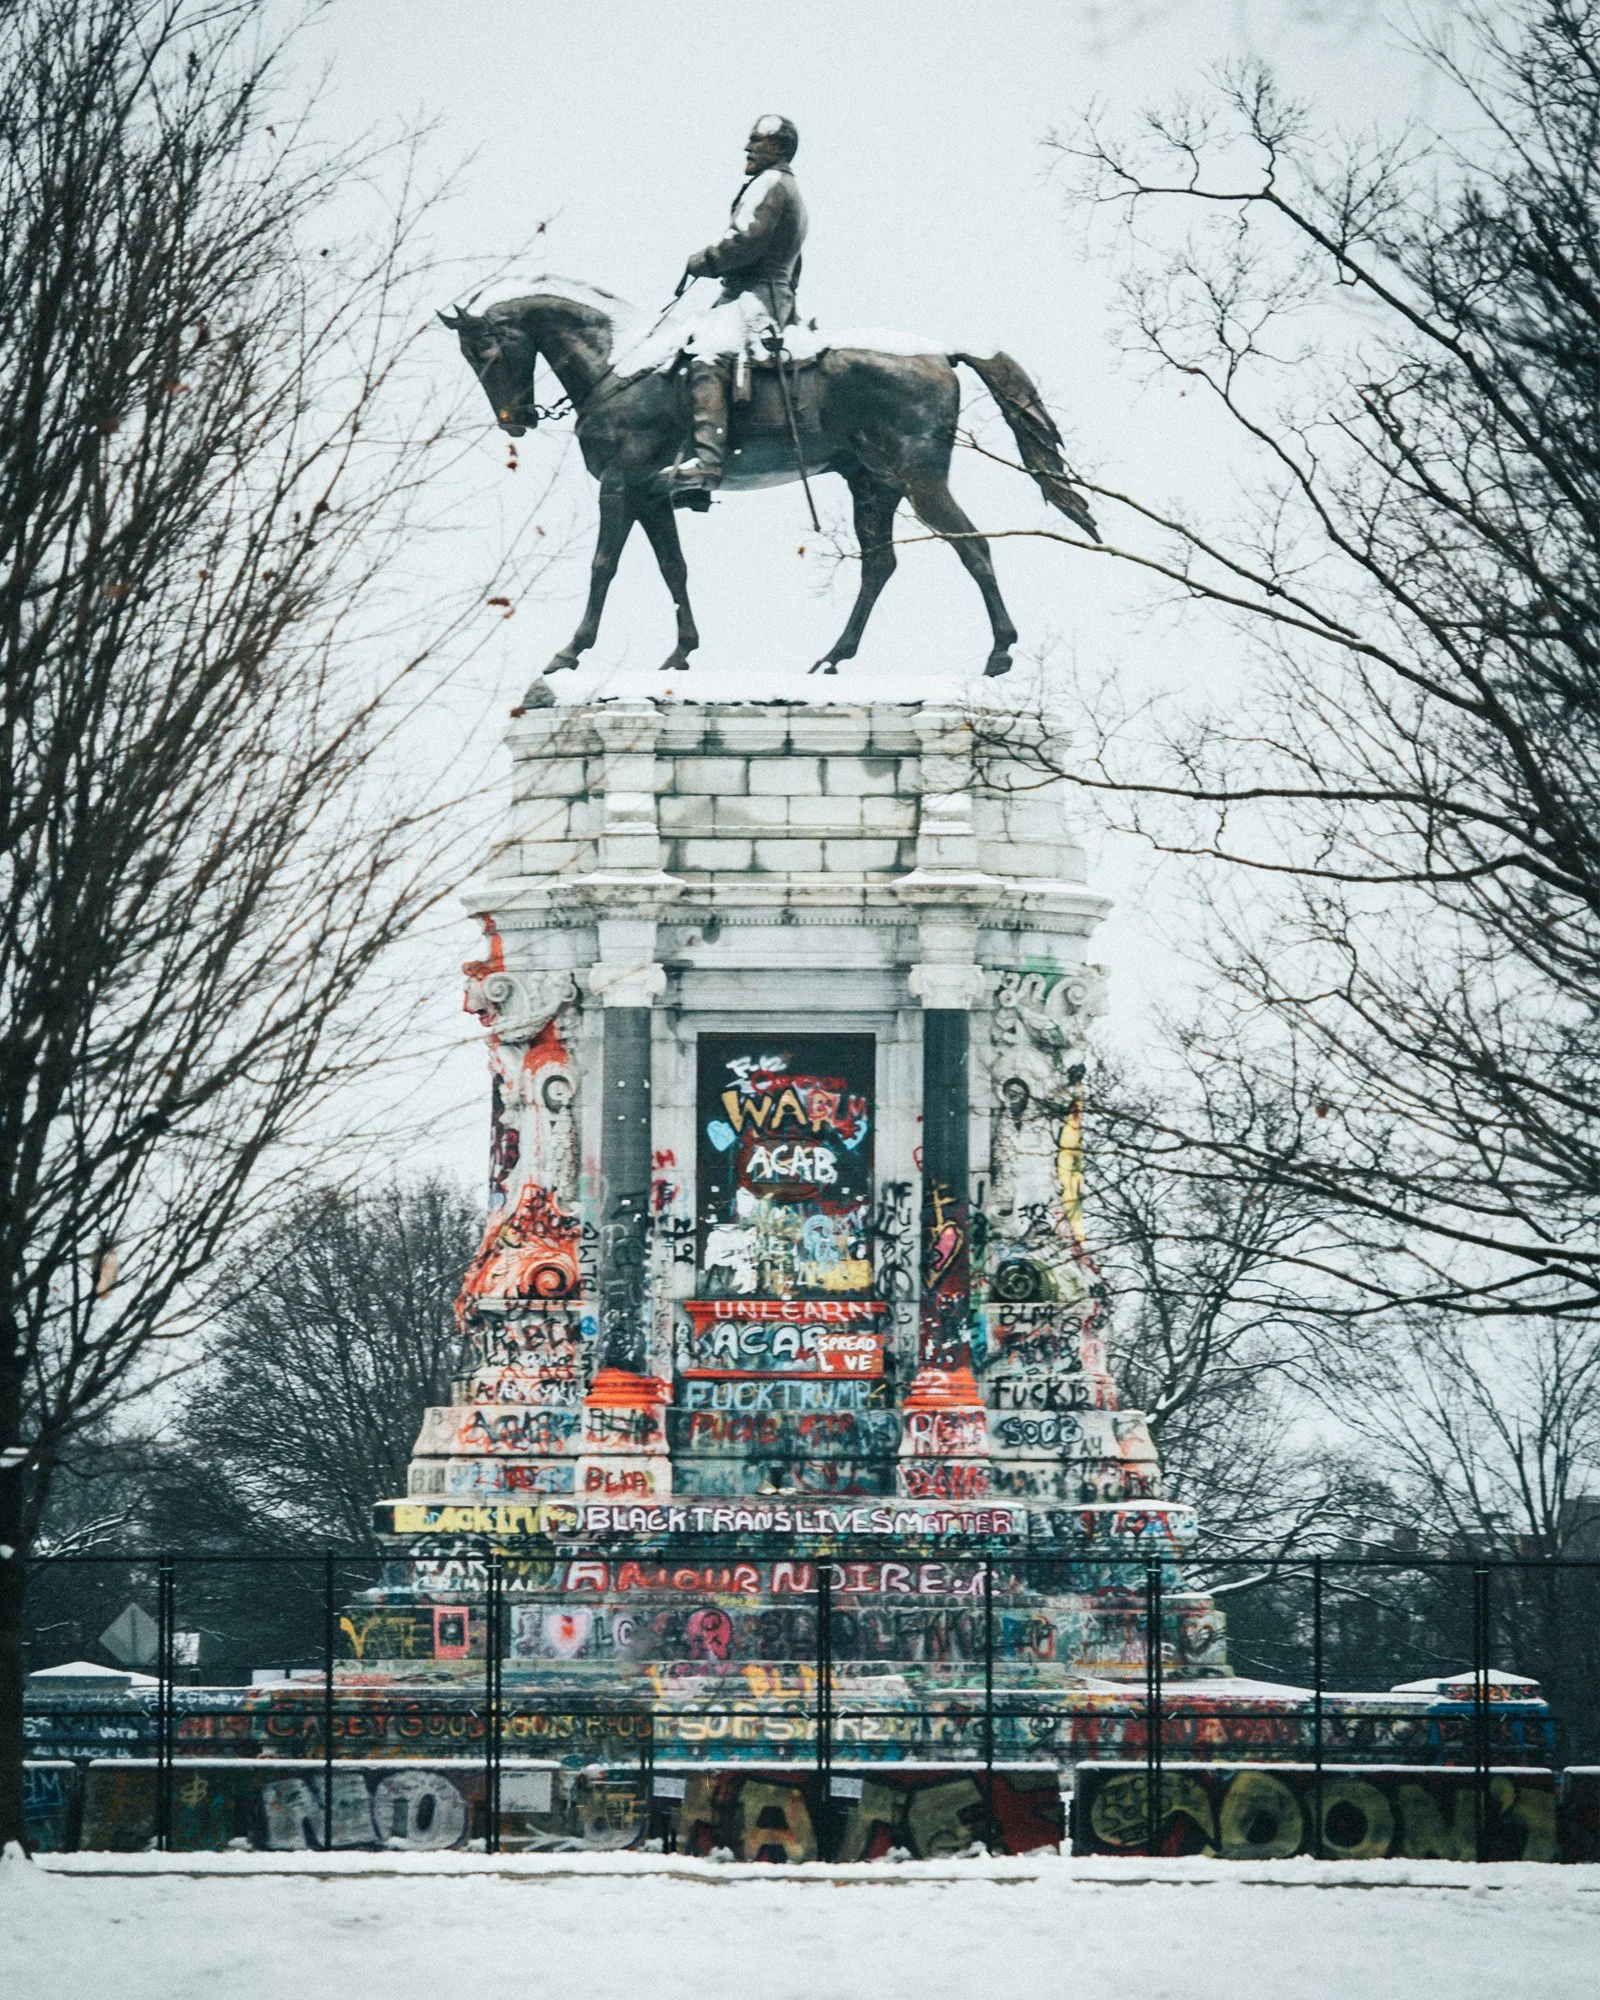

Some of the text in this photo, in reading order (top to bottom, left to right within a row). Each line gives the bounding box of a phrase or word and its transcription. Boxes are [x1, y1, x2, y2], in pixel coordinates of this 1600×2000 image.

[746, 1145, 838, 1185] ACAB
[714, 1301, 875, 1321] UNLEARN
[818, 1335, 877, 1352] SPREAD
[686, 1381, 871, 1411] FUCK TRUMP
[989, 1376, 1062, 1410] FUCK
[586, 1506, 1012, 1534] BLACK TRANS LIVES MATTER
